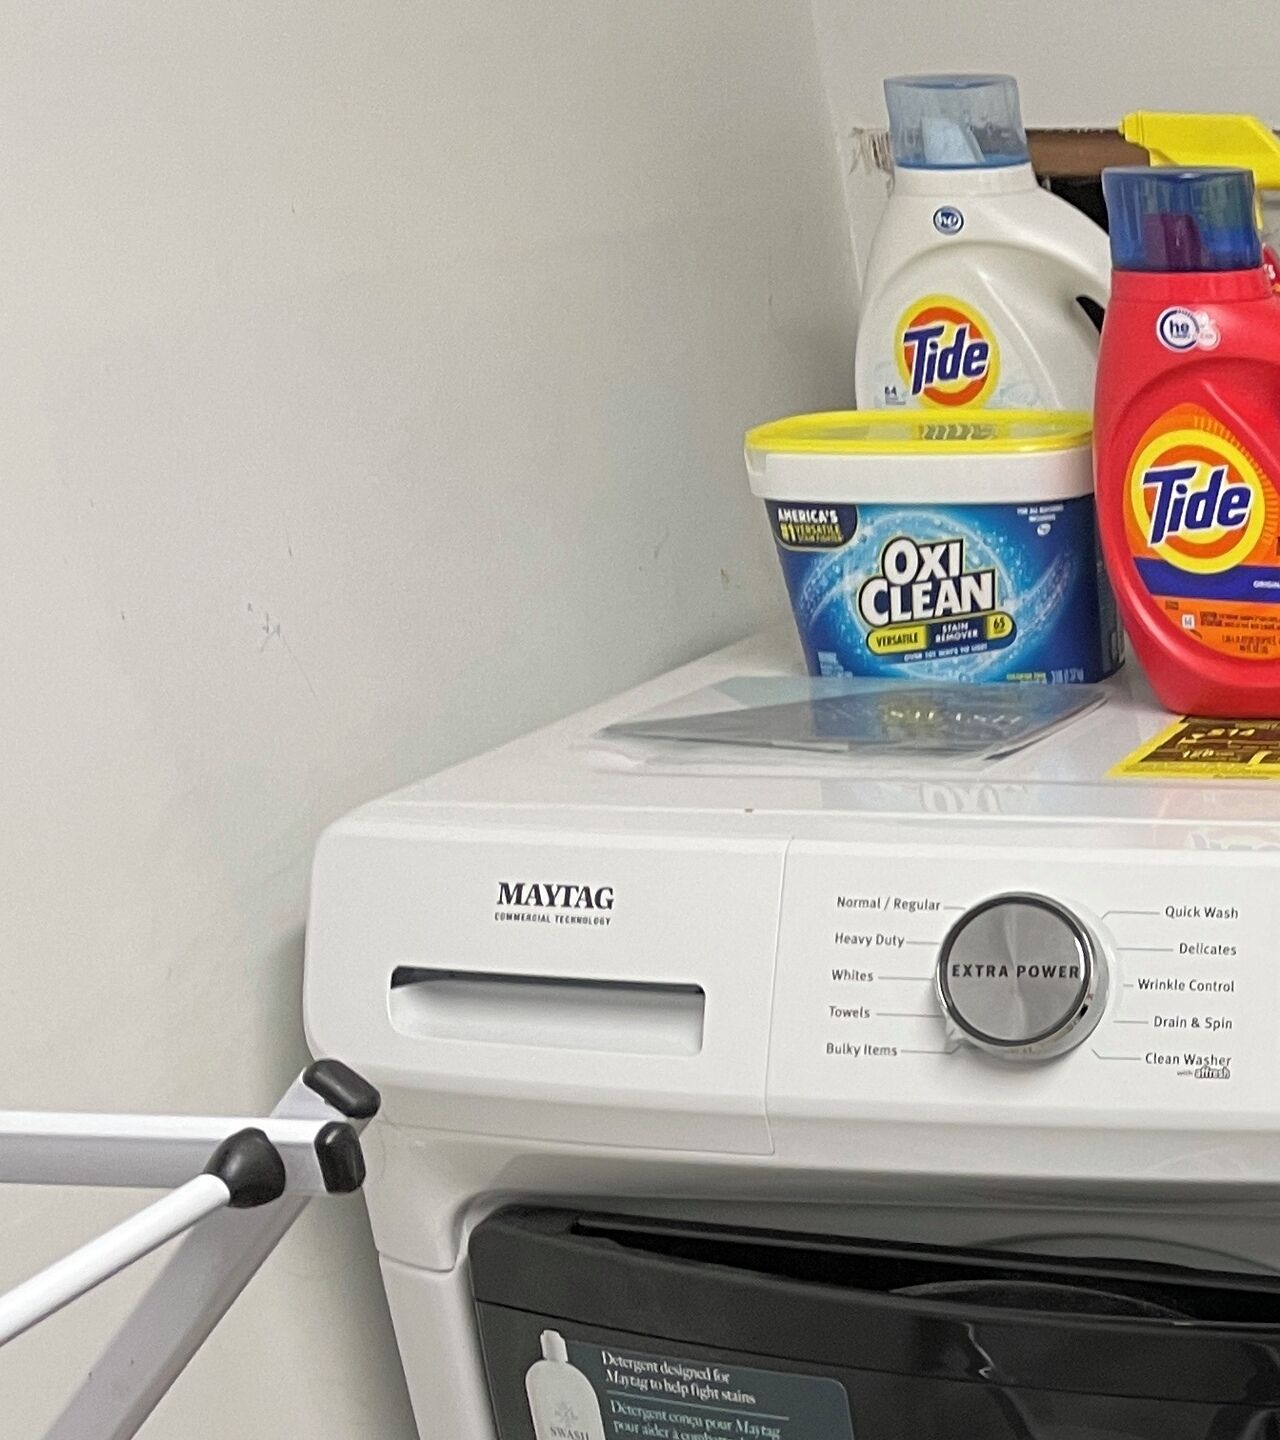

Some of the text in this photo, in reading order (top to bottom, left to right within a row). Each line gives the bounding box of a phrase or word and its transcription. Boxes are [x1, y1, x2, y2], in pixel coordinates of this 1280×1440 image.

[903, 324, 989, 396] Tide
[1143, 465, 1251, 545] Tide
[778, 507, 838, 524] AMERICA'S
[884, 537, 964, 583] OXI
[860, 571, 996, 626] CLEAN
[942, 622, 968, 634] STAIN
[993, 616, 1006, 630] 65
[876, 632, 918, 647] VERSATILE
[935, 629, 978, 643] REMOVER
[497, 882, 615, 910] MAYTAG
[836, 897, 881, 910] Normal
[893, 898, 941, 913] Regular
[1165, 906, 1239, 919] Quick Wash
[495, 912, 611, 926] COMMERCIAL TECHNOLOGY
[834, 933, 904, 949] Heavy Duty
[1179, 943, 1237, 956] Delicates
[831, 969, 874, 982] Whites
[952, 964, 1080, 979] EXTRA POWER
[1138, 978, 1235, 993] Wrinkle Control
[829, 1006, 870, 1019] Towels
[1154, 1016, 1233, 1031] Drain & Spin
[826, 1043, 897, 1058] Bulky Items
[1145, 1052, 1232, 1067] Clean Washer
[601, 1350, 730, 1384] Detergent designed for
[605, 1369, 756, 1404] Maytag to help fight stains
[613, 1420, 639, 1434] pour
[641, 1422, 669, 1439] aider
[668, 1411, 702, 1428] conçu
[705, 1417, 731, 1431] pour
[736, 1419, 781, 1440] Maytag
